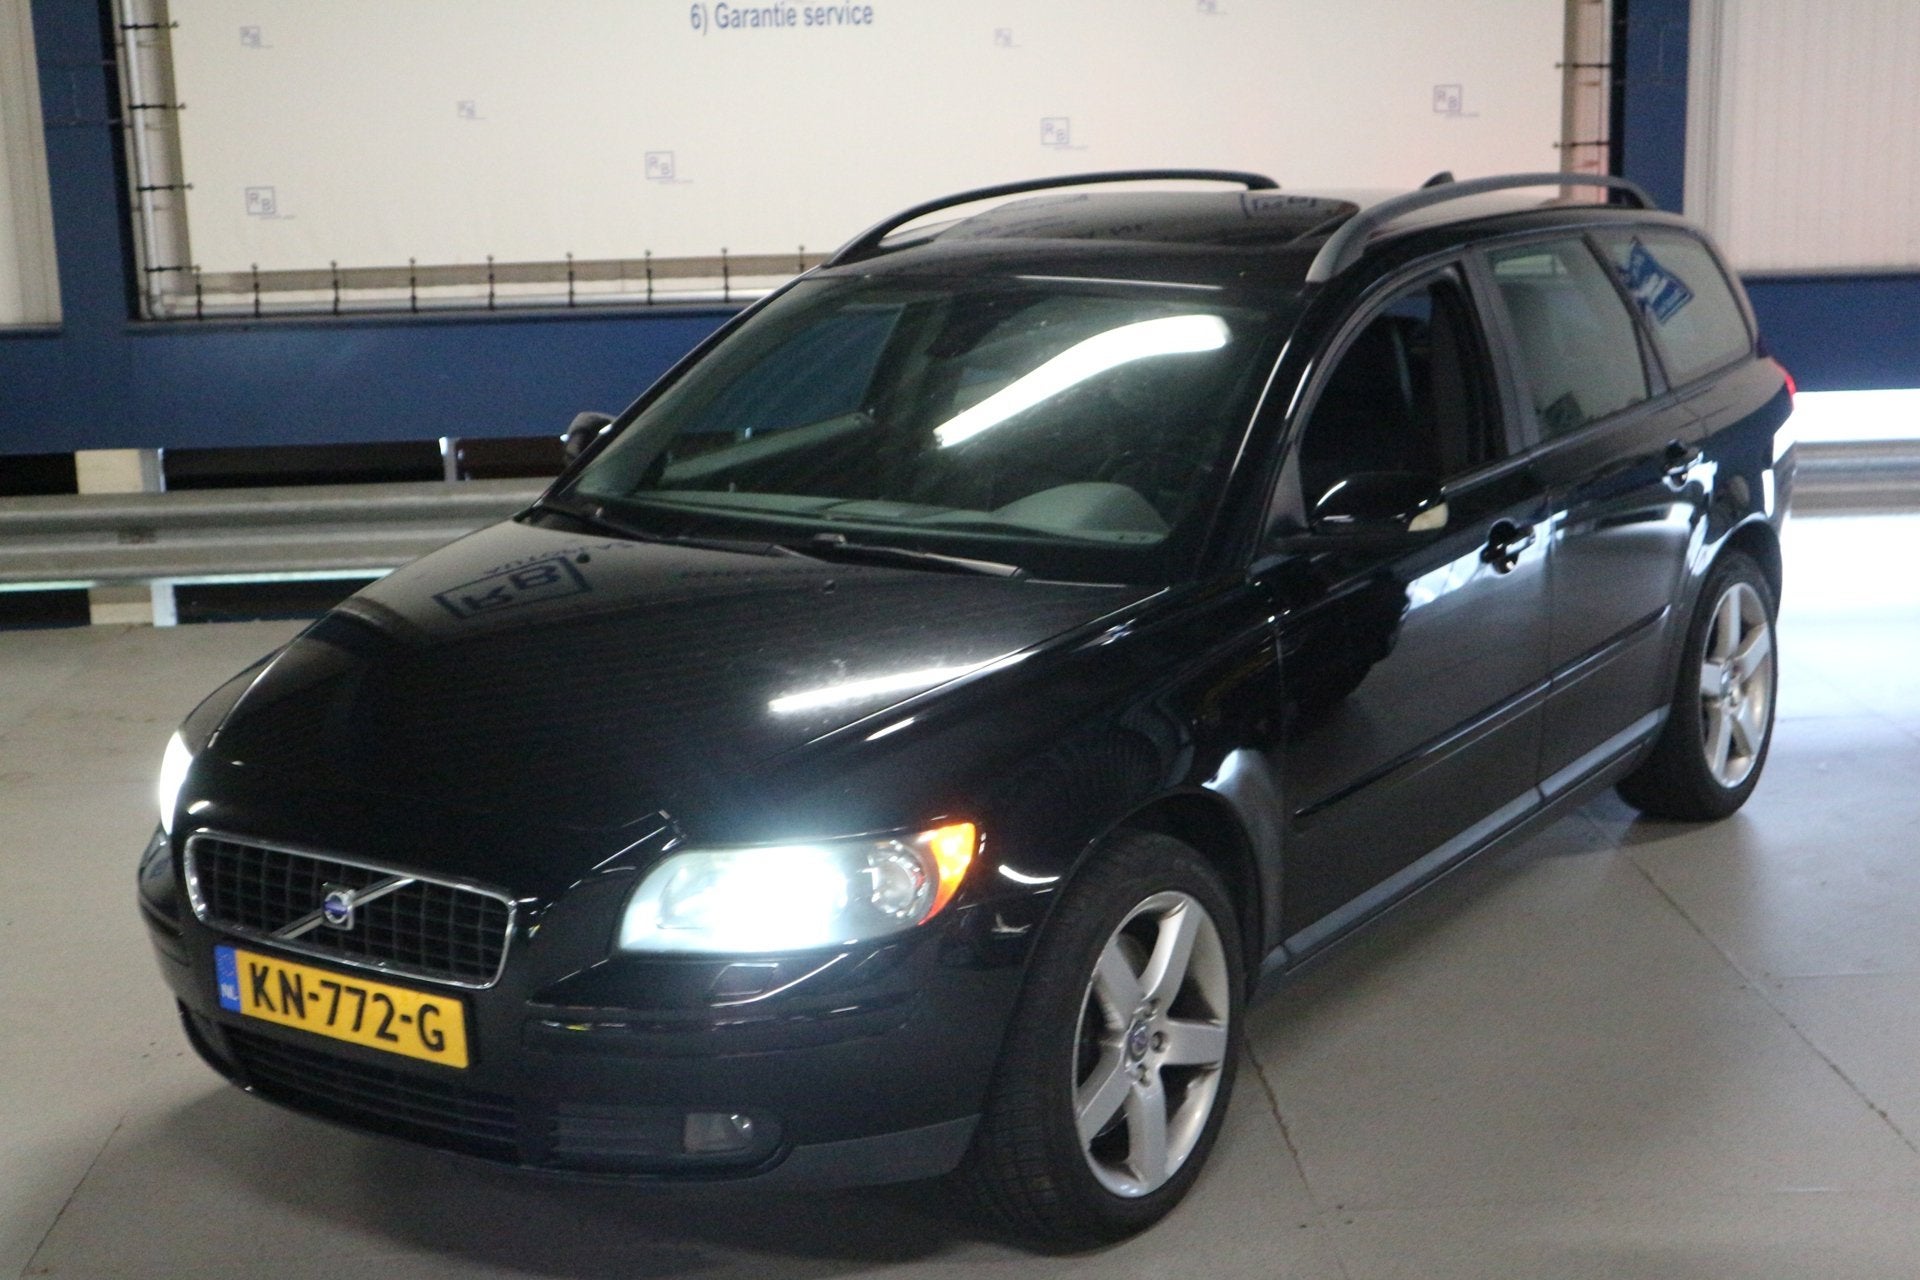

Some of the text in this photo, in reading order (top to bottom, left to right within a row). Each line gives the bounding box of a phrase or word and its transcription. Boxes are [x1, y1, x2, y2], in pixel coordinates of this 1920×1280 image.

[690, 1, 874, 36] 6) Garantie service
[249, 962, 446, 1052] KN-772-G
